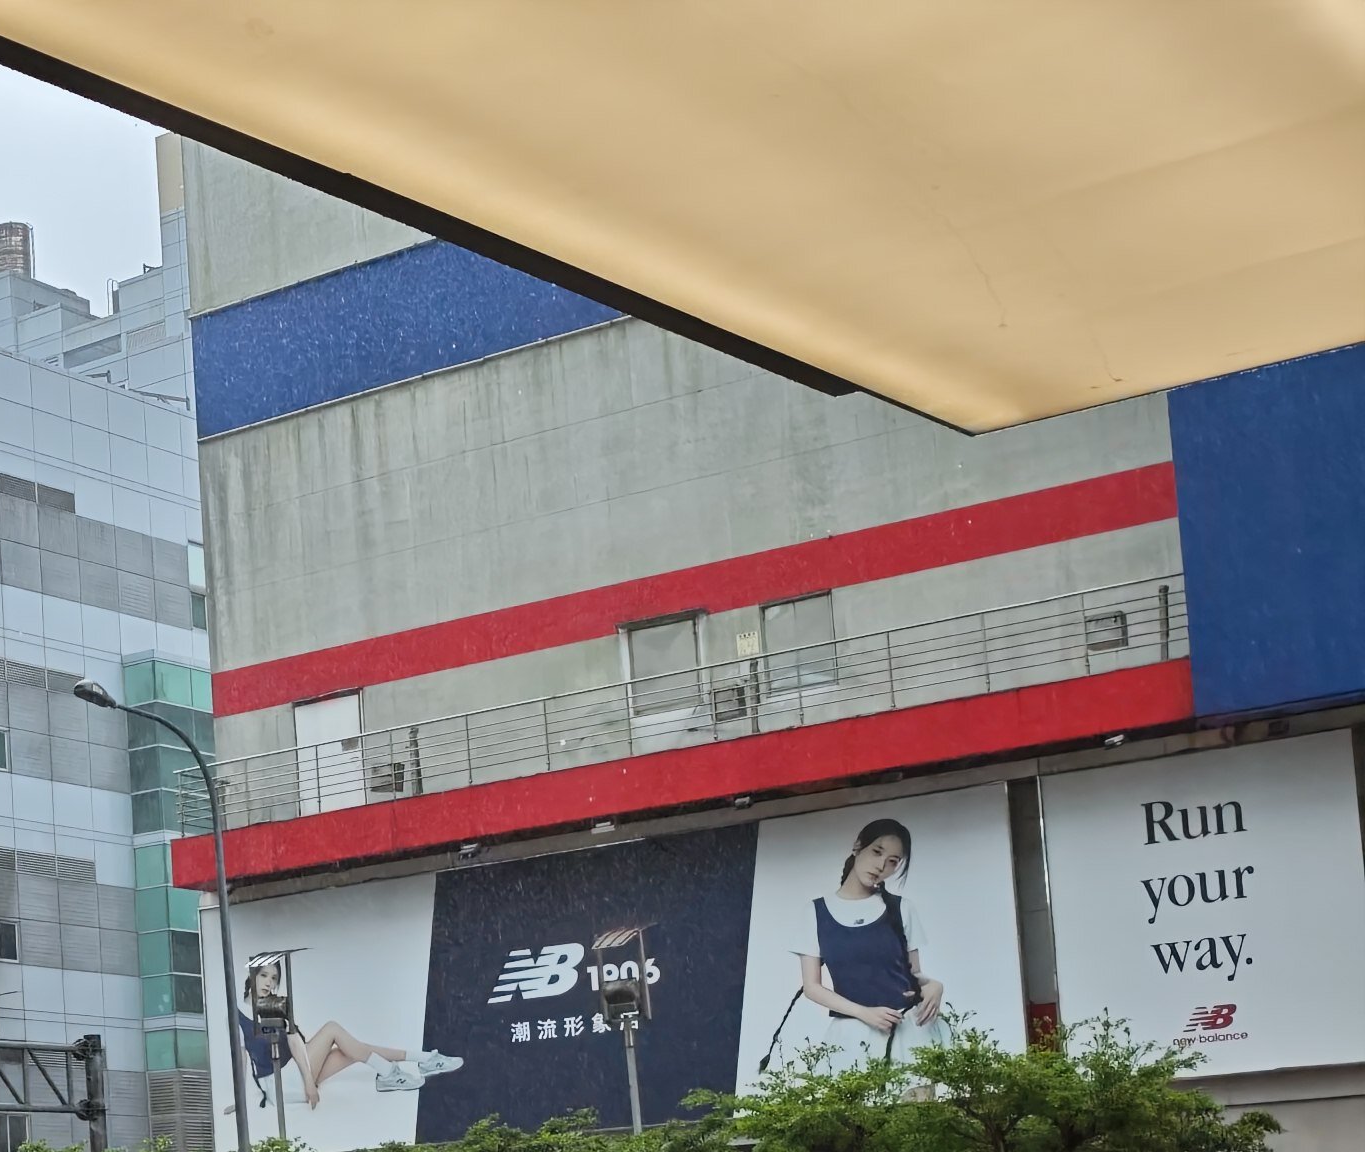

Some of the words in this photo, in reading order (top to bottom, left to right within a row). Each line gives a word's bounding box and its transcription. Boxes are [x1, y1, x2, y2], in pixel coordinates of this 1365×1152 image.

[1141, 800, 1248, 846] Run
[1141, 865, 1255, 924] your
[487, 943, 585, 1004] NB
[586, 957, 661, 992] 1906
[1150, 933, 1253, 982] way.
[1199, 1031, 1249, 1044] balance
